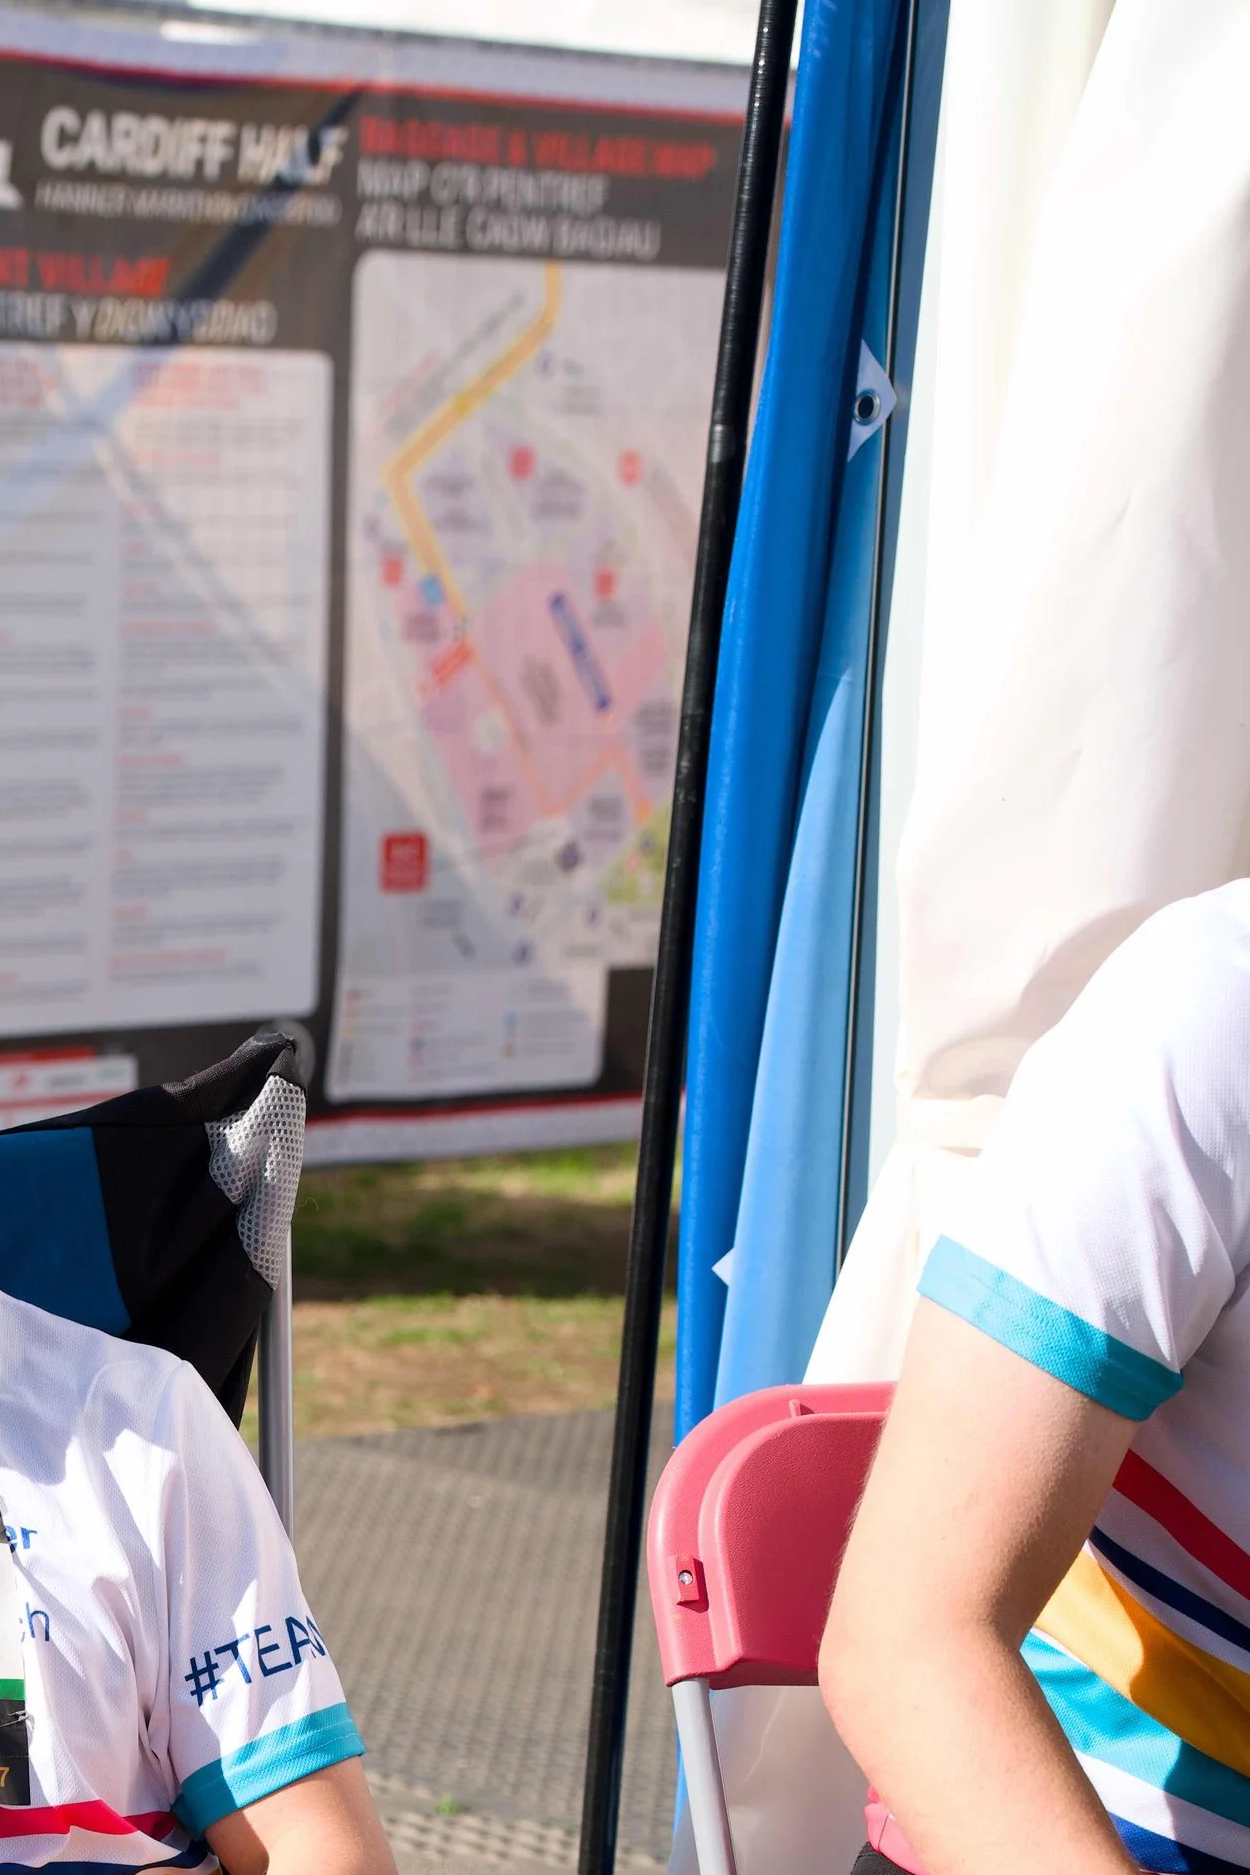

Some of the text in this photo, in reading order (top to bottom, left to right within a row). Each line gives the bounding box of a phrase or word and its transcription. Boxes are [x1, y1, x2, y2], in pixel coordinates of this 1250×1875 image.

[41, 106, 348, 186] CARDIFF HALF
[357, 157, 430, 198] MAP
[483, 168, 611, 213] PENTREF
[405, 203, 463, 248] LLE
